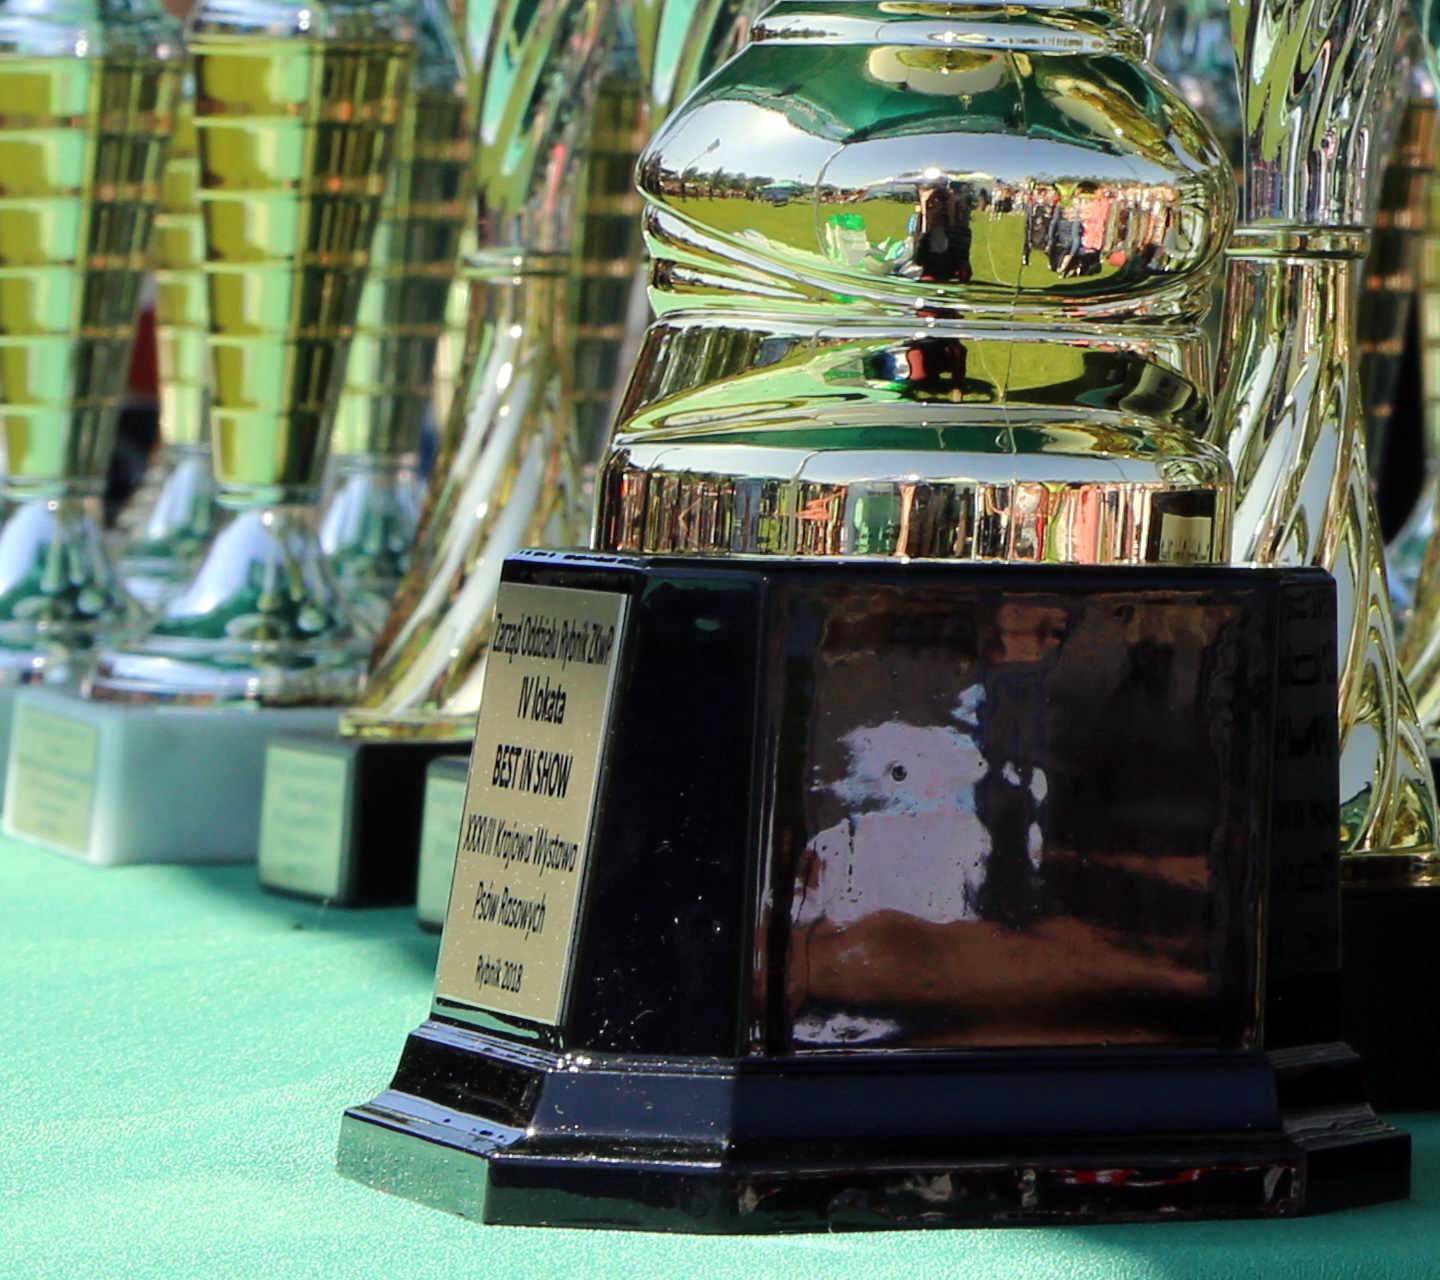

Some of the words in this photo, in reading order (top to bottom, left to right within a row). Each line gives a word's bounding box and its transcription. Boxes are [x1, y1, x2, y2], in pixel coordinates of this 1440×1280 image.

[531, 675, 566, 724] lokata
[492, 744, 522, 790] BEST
[533, 750, 573, 798] SHOW
